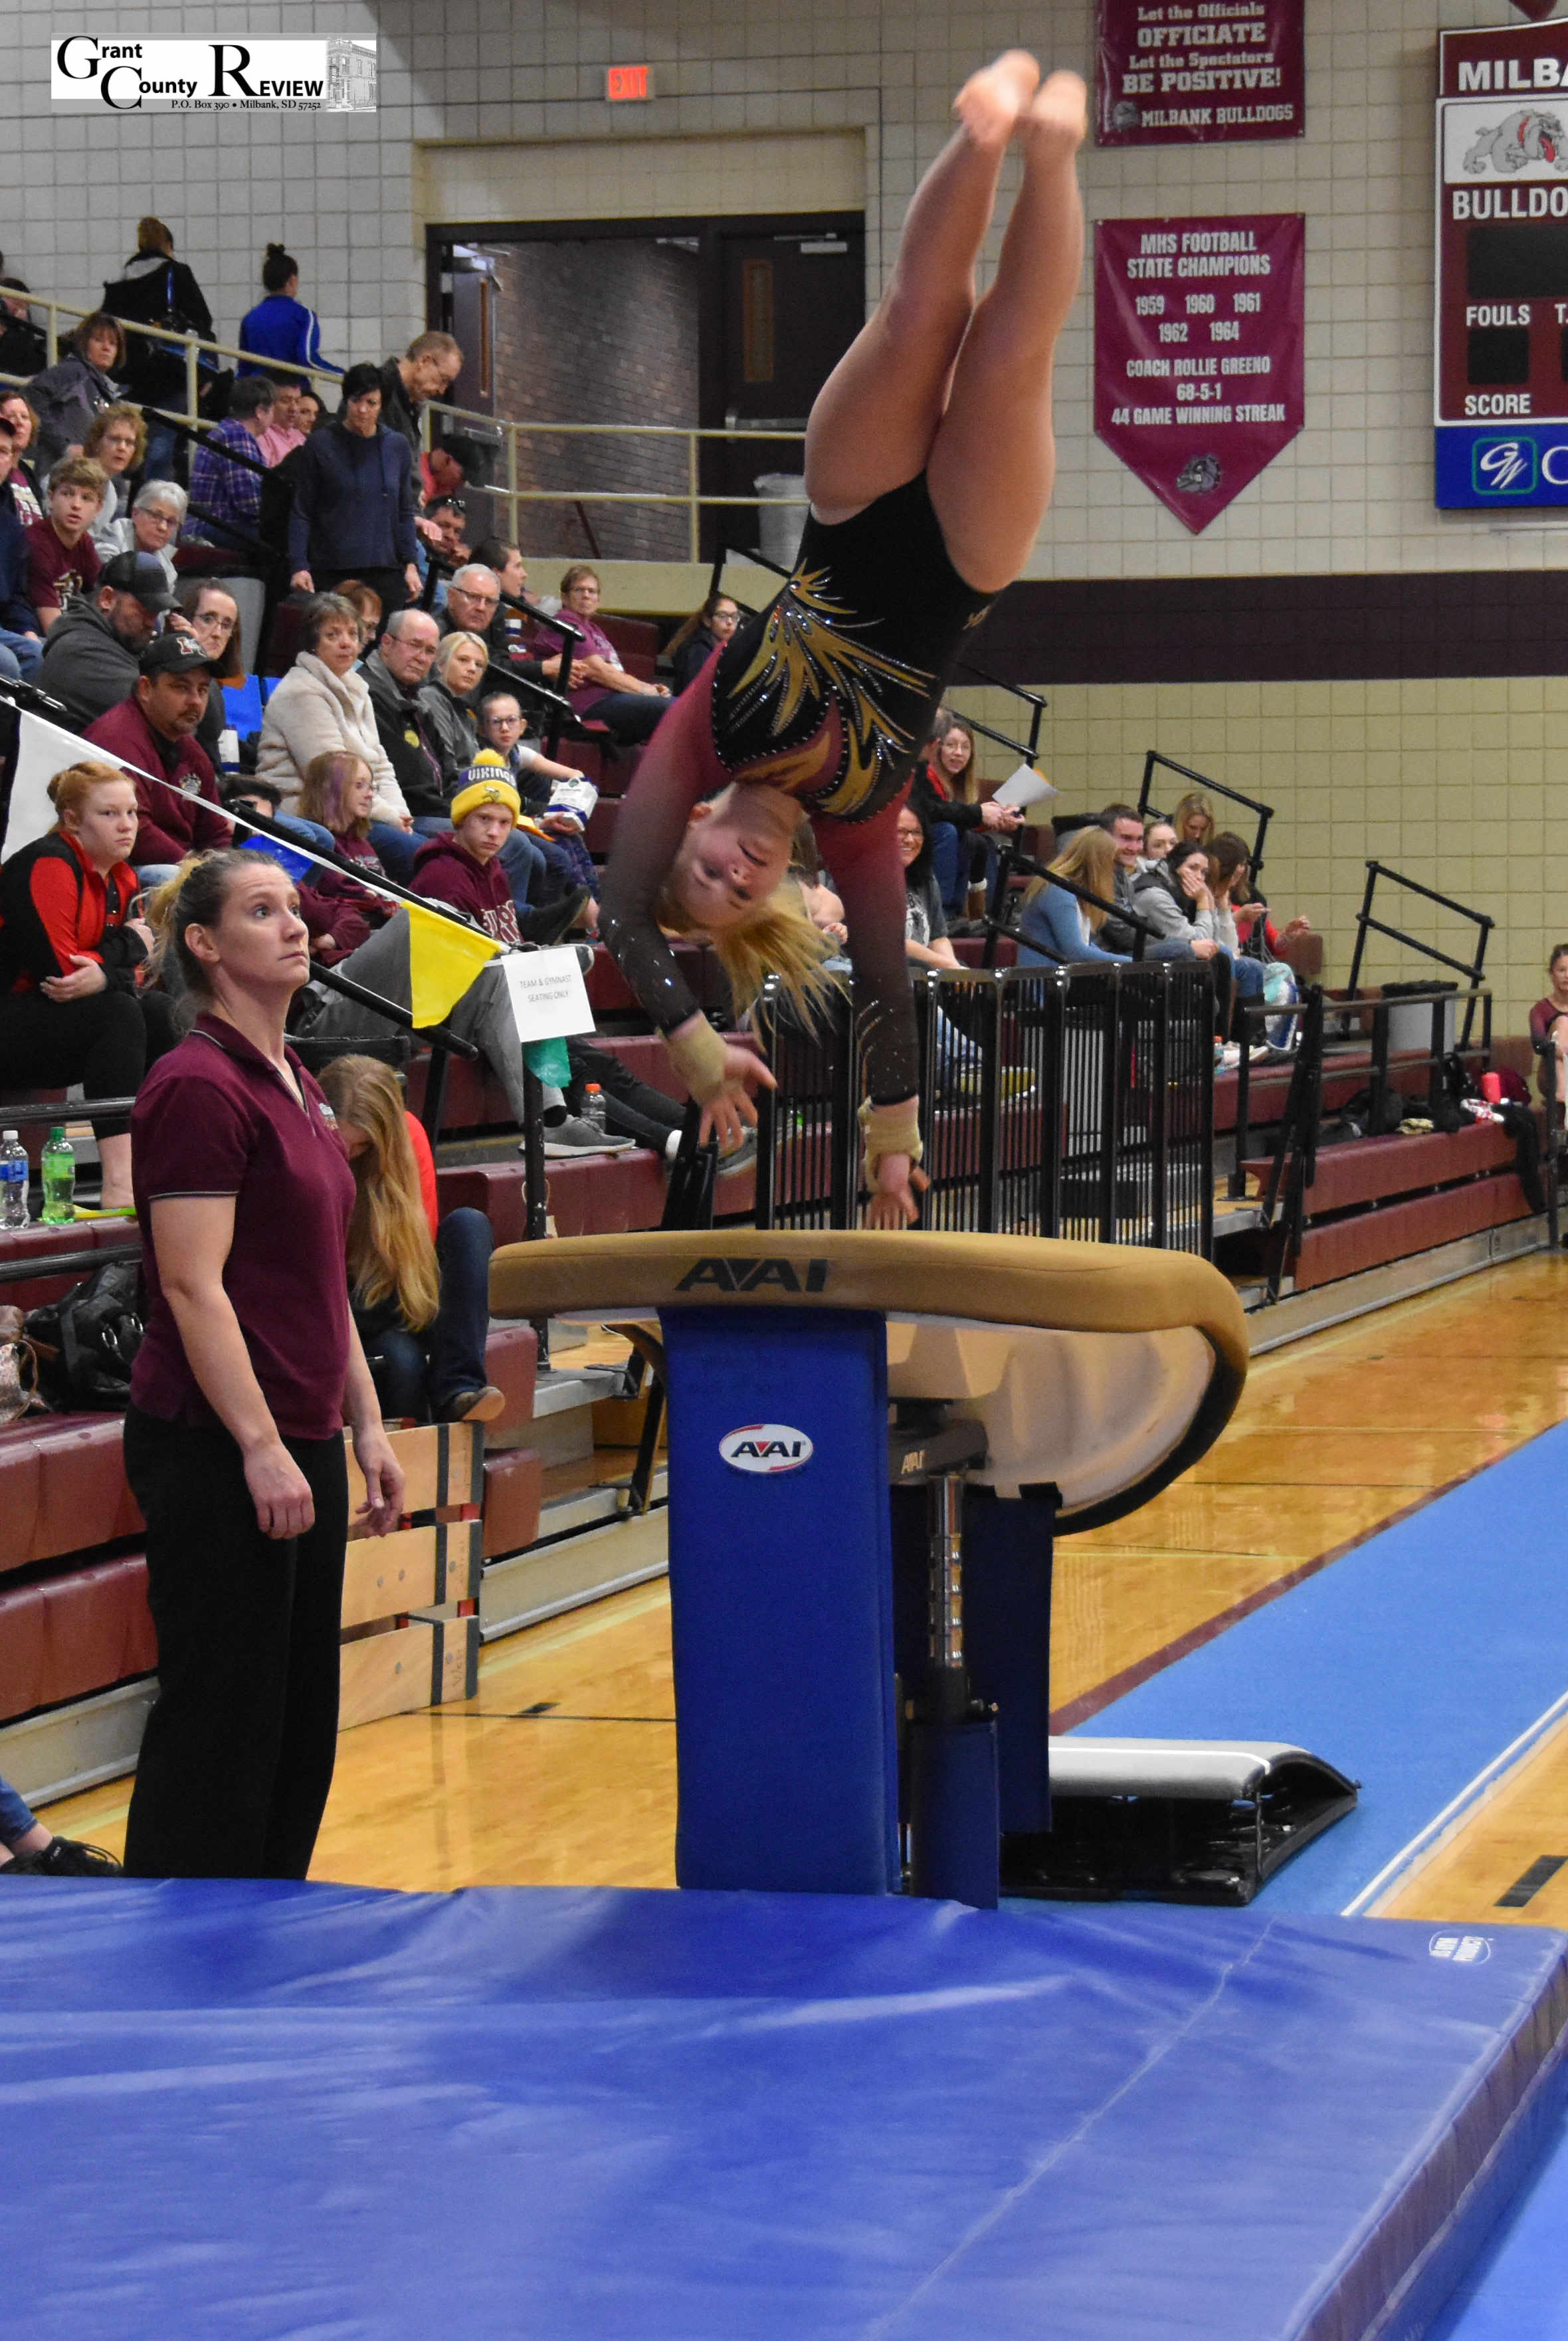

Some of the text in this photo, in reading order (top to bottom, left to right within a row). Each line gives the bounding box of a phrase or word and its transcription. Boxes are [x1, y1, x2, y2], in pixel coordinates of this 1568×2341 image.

[1137, 1, 1264, 21] Let the Officials
[1137, 22, 1266, 47] OFFICIATE
[1129, 51, 1274, 70] Let the Spectators
[1122, 67, 1281, 94] BE POSITIVE!
[1141, 104, 1294, 128] MILBANK BULLDOGS
[1141, 231, 1257, 254] MHS FOOTBALL
[1127, 254, 1271, 278] STATE CHAMPIONS
[1135, 292, 1260, 316] 1959 1960 1961
[1466, 304, 1530, 327] FOULS
[1159, 321, 1239, 342] 1962 1964
[1126, 359, 1169, 377] COACH
[1173, 357, 1217, 376] ROLLIE
[1176, 383, 1222, 401] 68-5-1
[1111, 404, 1285, 425] 44 GAME WINNING STREAK
[1464, 394, 1531, 415] SCORE
